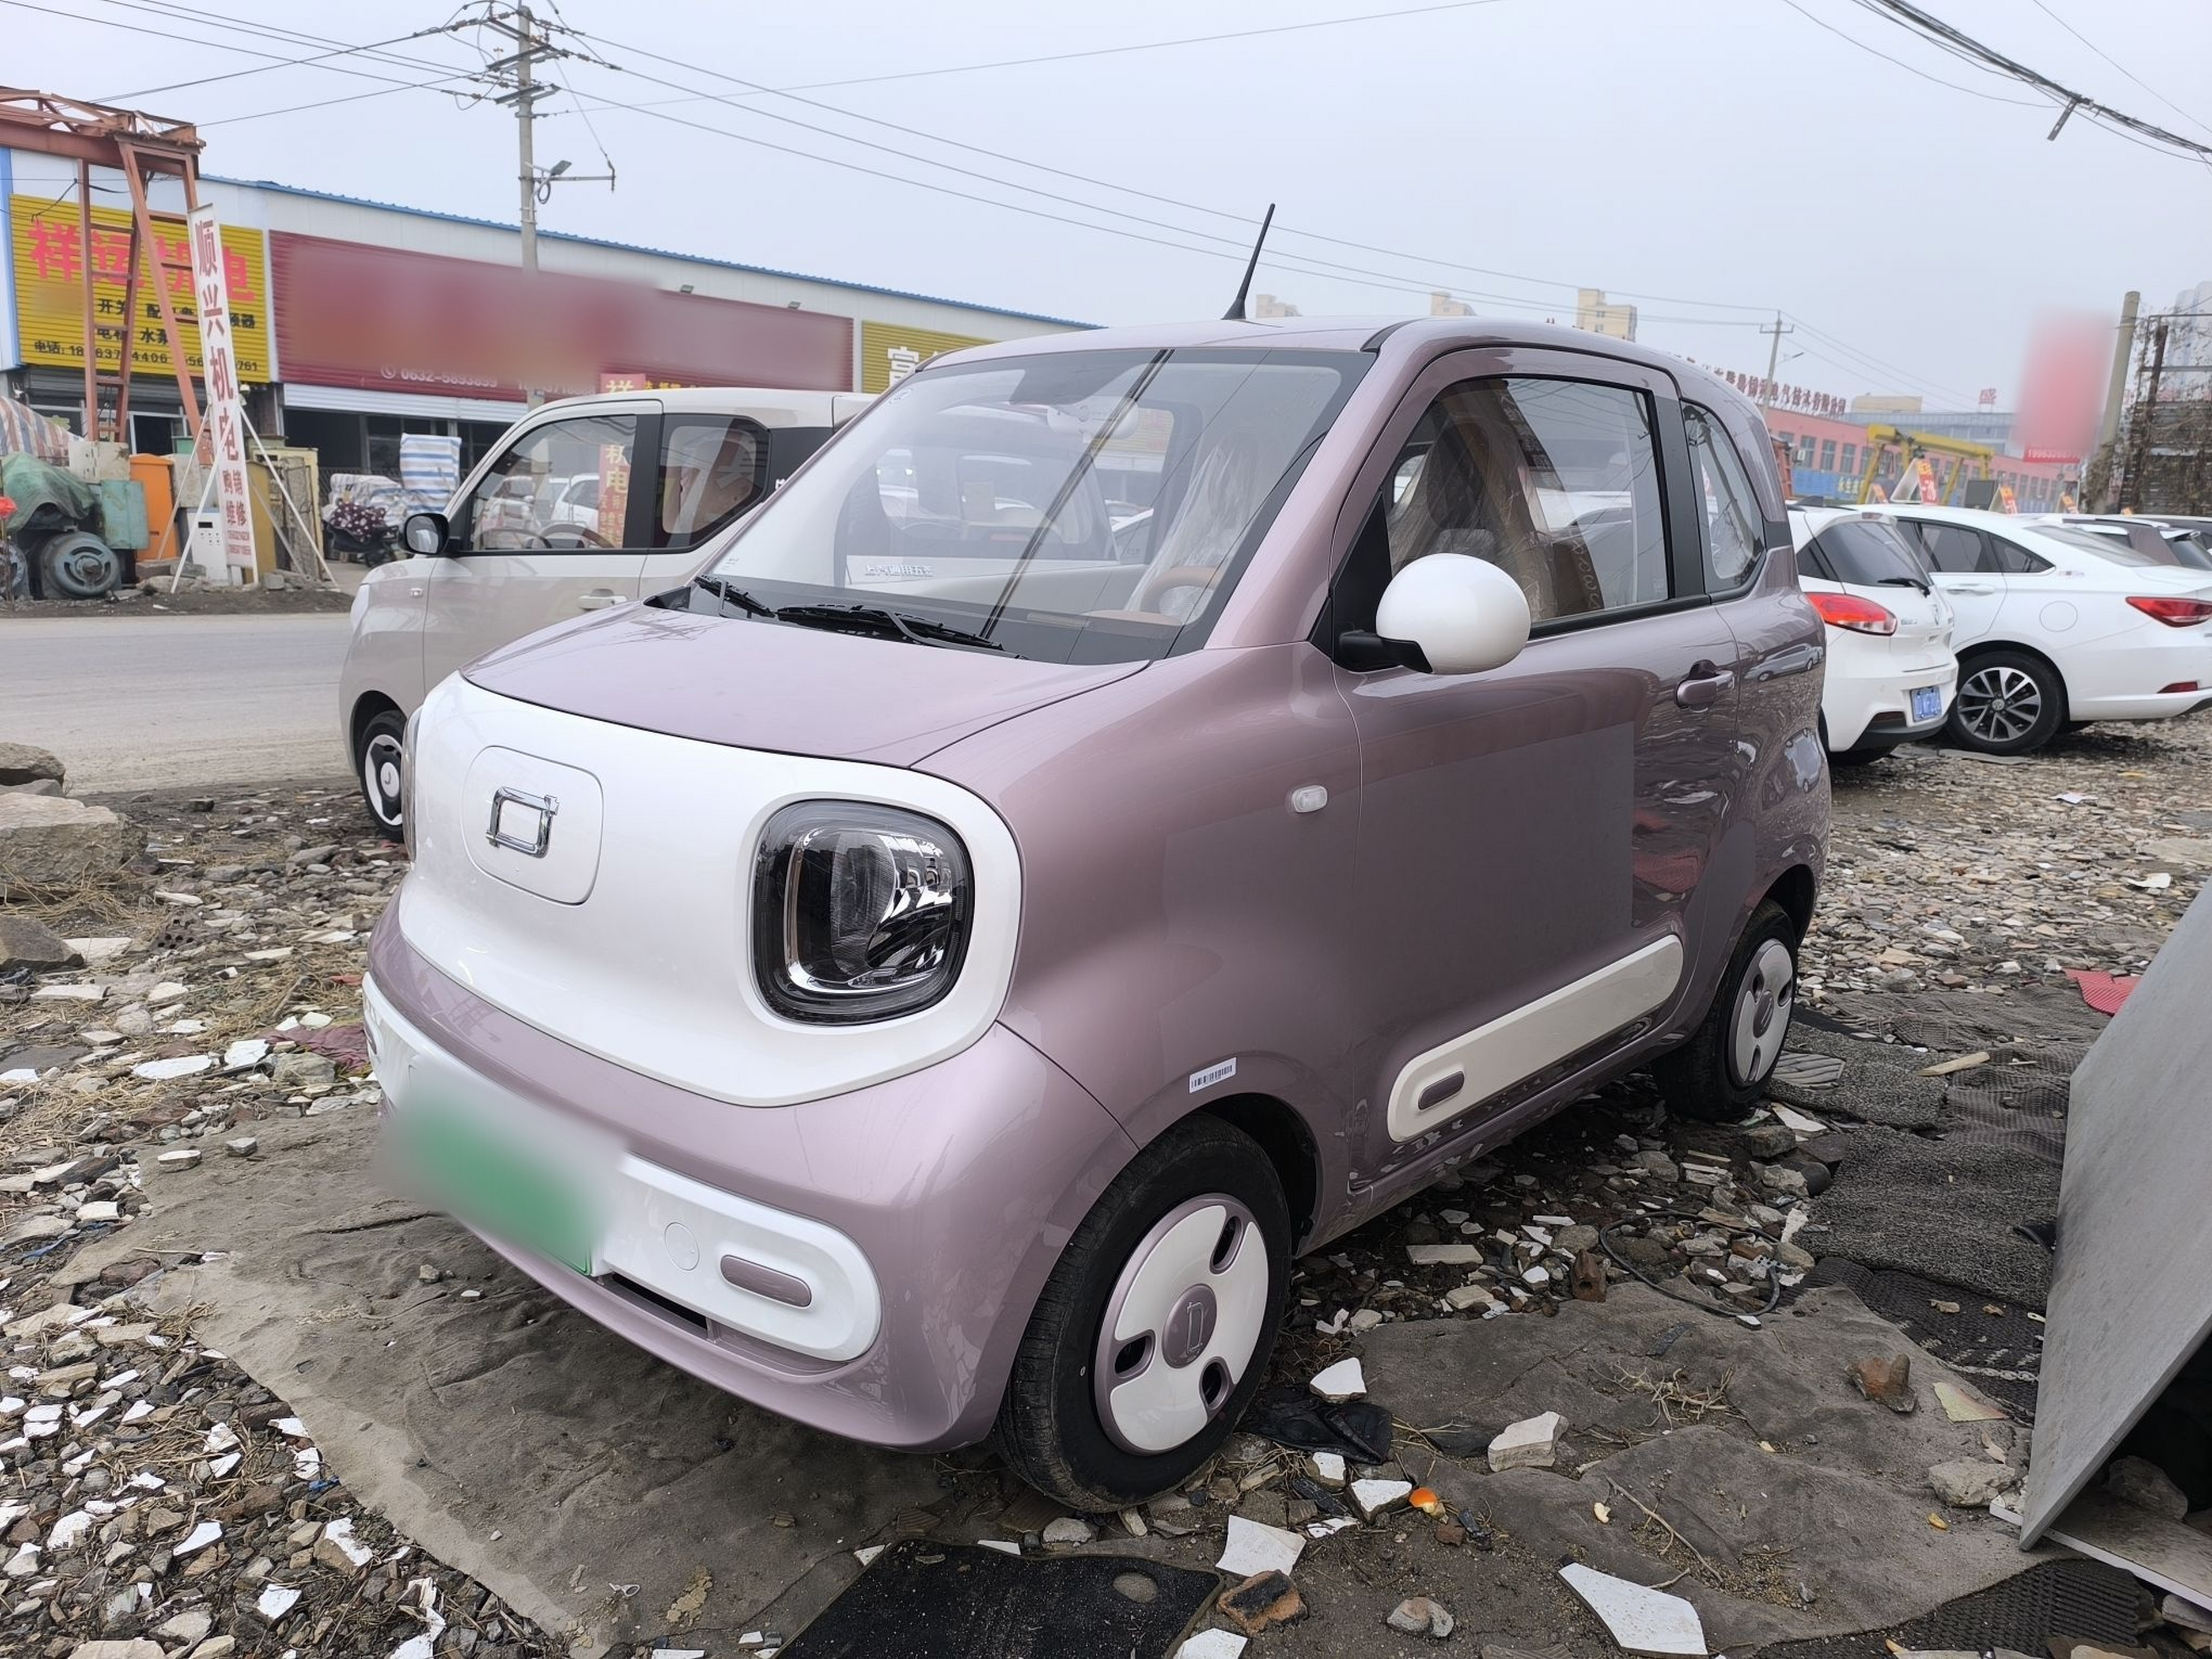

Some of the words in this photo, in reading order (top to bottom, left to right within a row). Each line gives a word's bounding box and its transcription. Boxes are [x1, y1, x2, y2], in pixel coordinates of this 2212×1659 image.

[69, 345, 168, 364] 186374406
[195, 219, 238, 460] 顺兴机电
